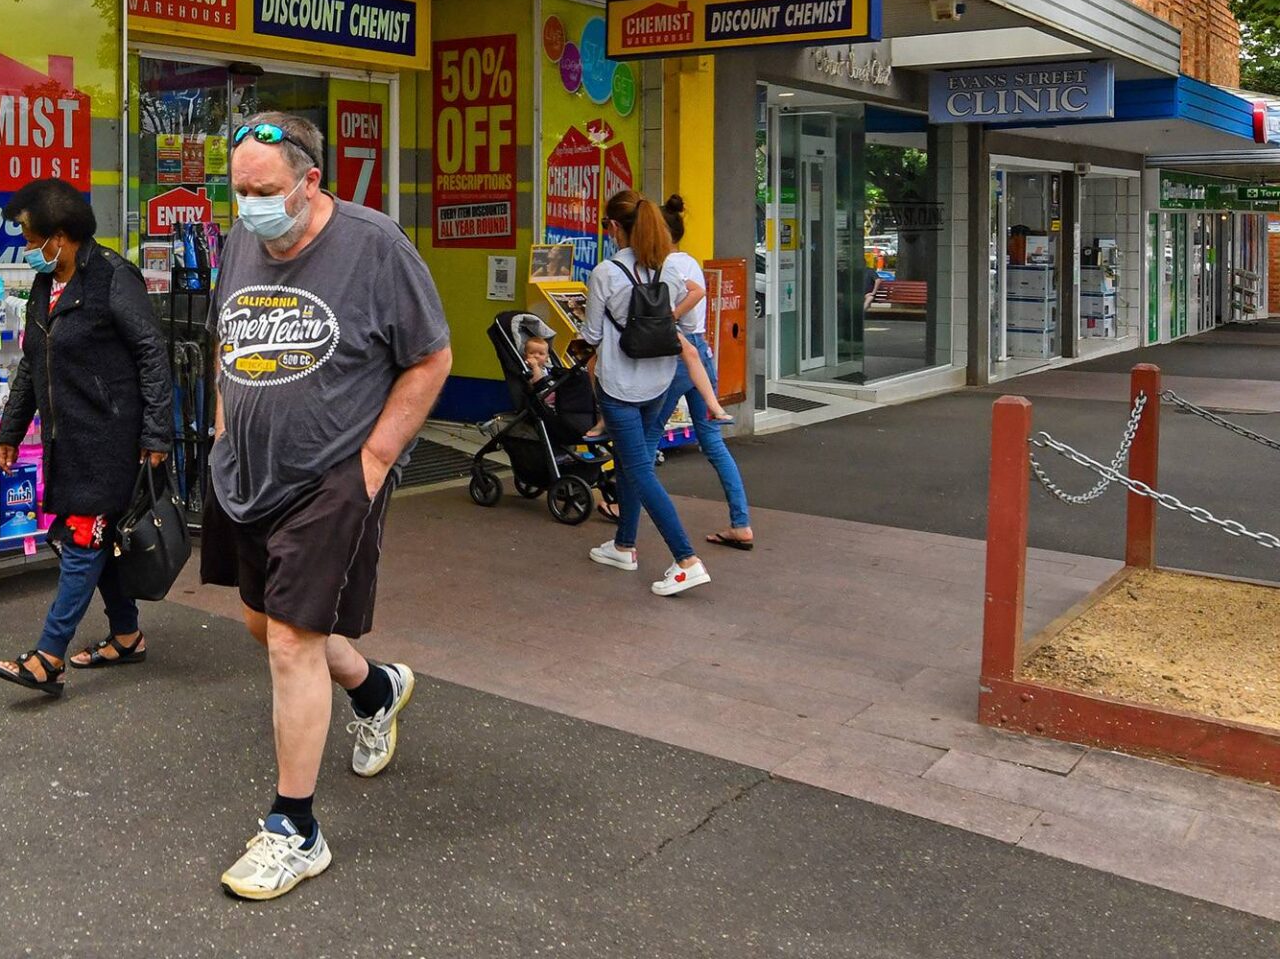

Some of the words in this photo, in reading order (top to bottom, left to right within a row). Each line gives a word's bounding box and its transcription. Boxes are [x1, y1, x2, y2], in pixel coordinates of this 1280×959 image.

[349, 4, 410, 44] CHEMIST
[626, 13, 690, 37] CHEMIST
[710, 6, 781, 34] DISCOUNT
[785, 0, 846, 25] CHEMIST
[626, 32, 692, 46] WAREHOUSE
[440, 45, 512, 102] 50%
[947, 74, 1008, 91] EVANS
[1014, 69, 1087, 86] STREET
[947, 86, 1089, 117] CLINIC
[341, 112, 378, 139] OPEN
[437, 104, 512, 174] OFF
[344, 146, 376, 205] 7
[437, 173, 512, 191] PRESCRIPTIONS
[548, 165, 599, 200] CHEMIST
[157, 206, 204, 226] ENTRY
[441, 208, 456, 220] EVERY
[458, 206, 471, 218] ITEM
[472, 203, 508, 217] DISCOUNTED
[441, 221, 453, 237] ALL
[454, 219, 474, 236] YEAR
[476, 215, 508, 235] ROUND!
[237, 295, 298, 307] CALIFORNIA
[283, 354, 298, 365] 500
[300, 354, 311, 365] CC
[7, 485, 32, 503] finish
